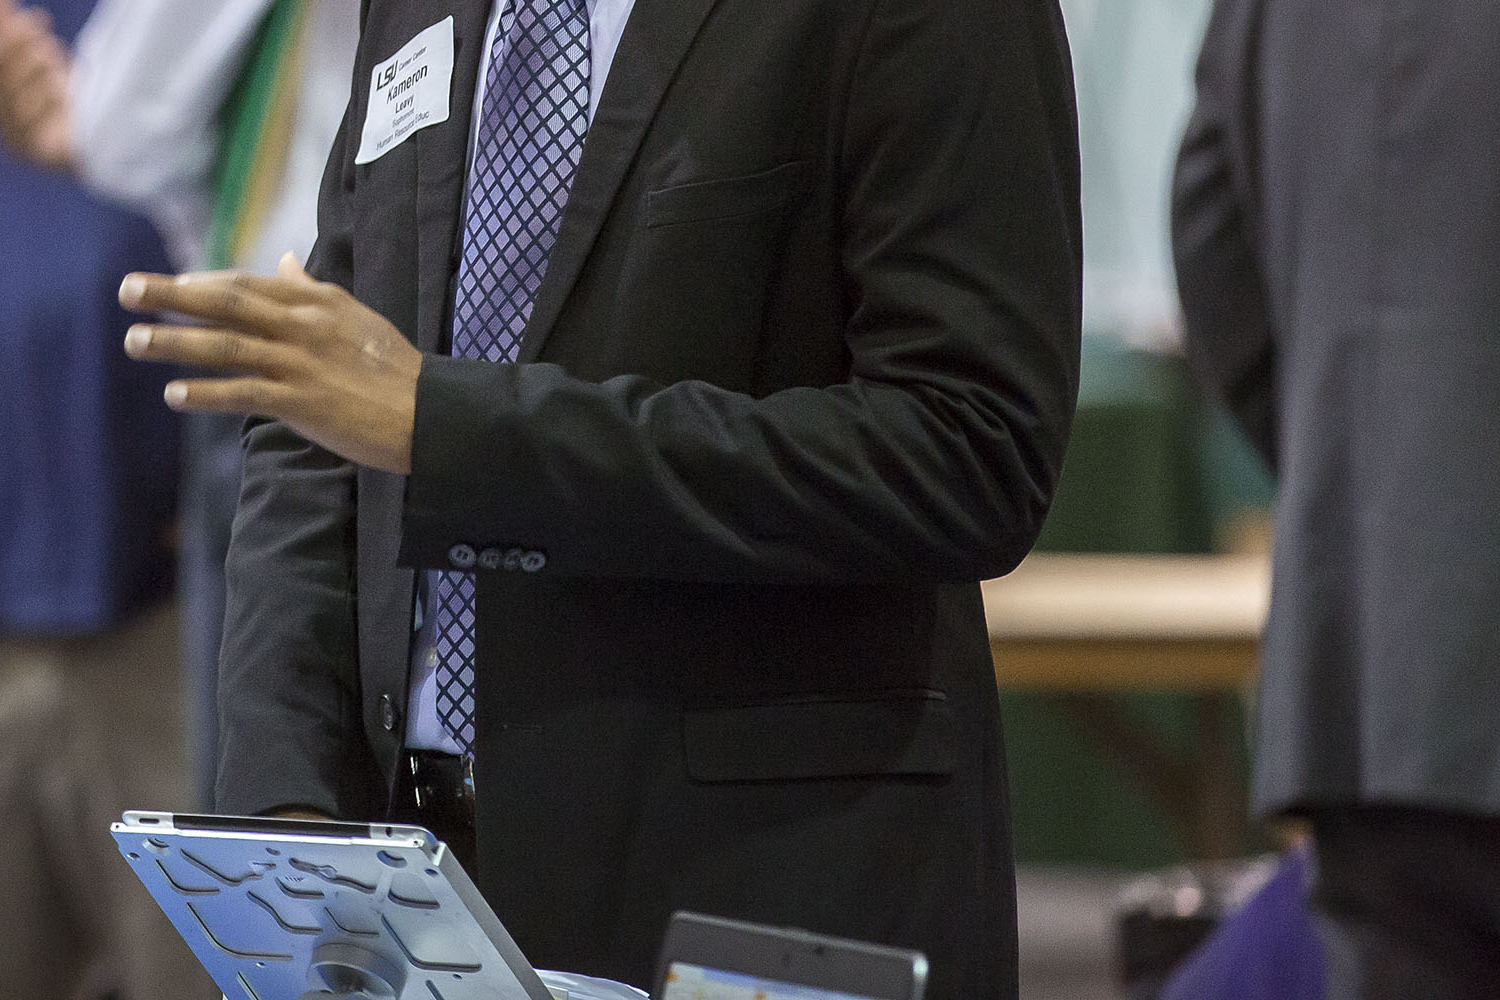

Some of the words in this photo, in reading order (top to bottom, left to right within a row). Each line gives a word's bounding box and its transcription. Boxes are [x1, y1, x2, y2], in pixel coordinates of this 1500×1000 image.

[376, 60, 398, 91] LSU
[386, 65, 428, 104] Kameron
[395, 94, 414, 114] Leavy
